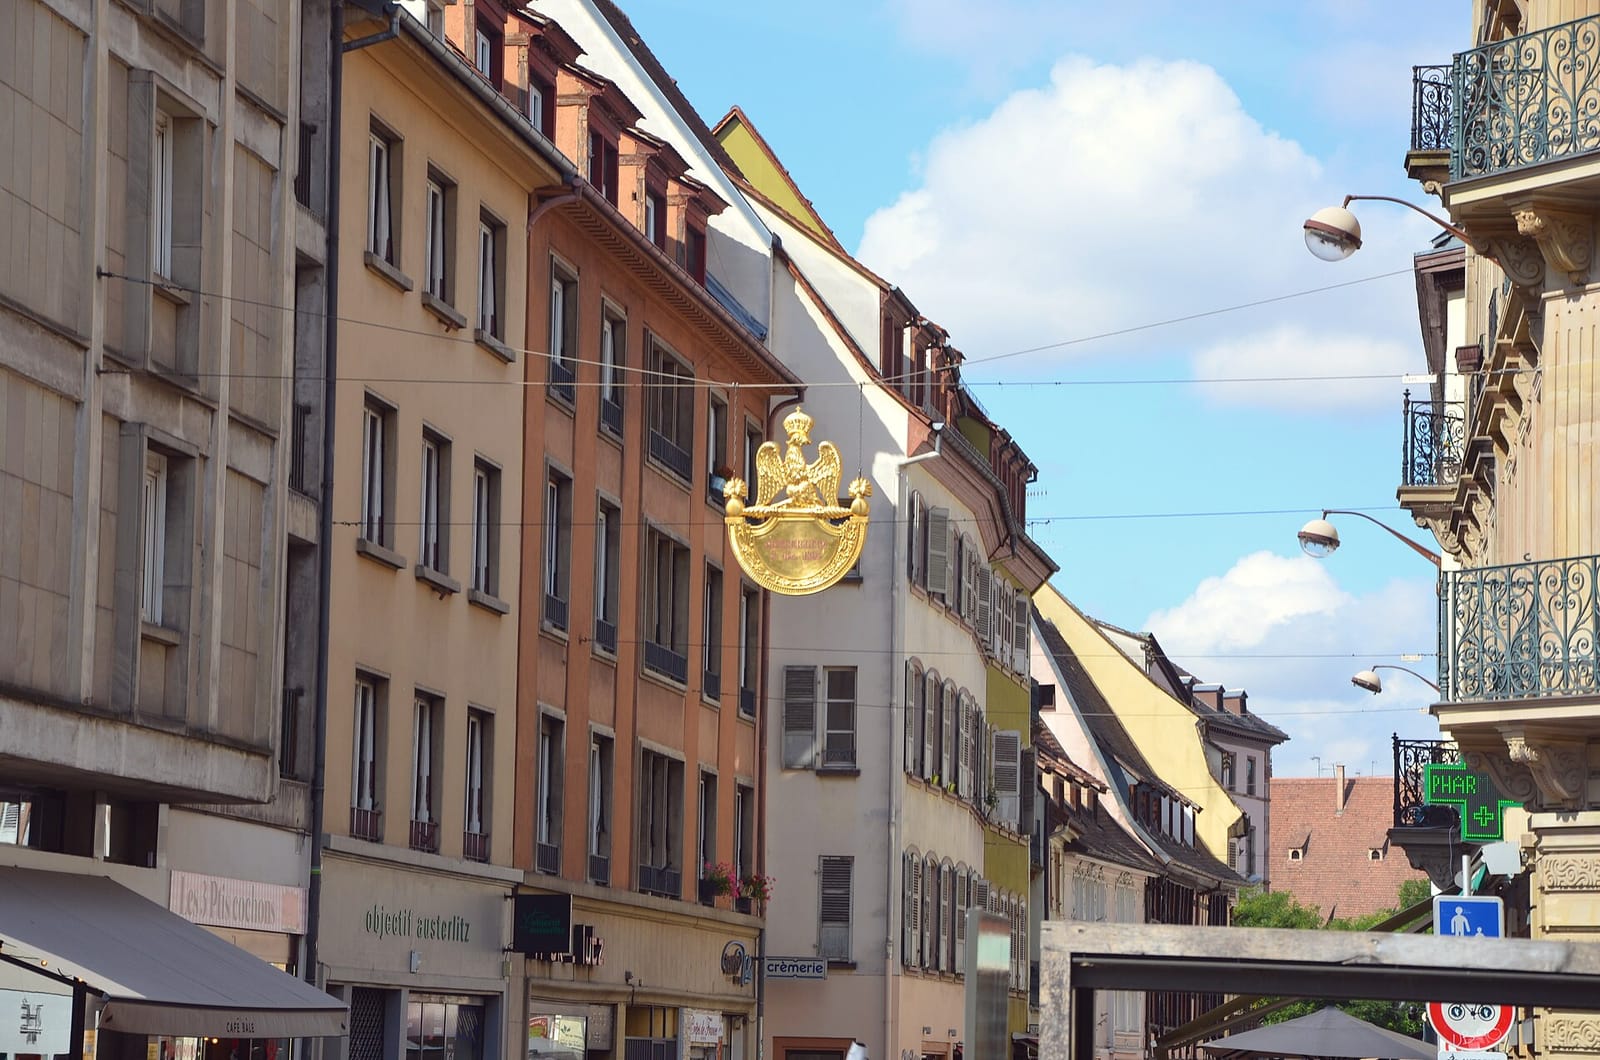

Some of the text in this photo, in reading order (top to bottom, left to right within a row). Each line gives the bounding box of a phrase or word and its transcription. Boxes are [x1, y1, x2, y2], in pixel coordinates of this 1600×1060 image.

[232, 884, 276, 924] cochons
[365, 904, 470, 942] objectif austerlitz
[767, 961, 823, 974] crèmerie
